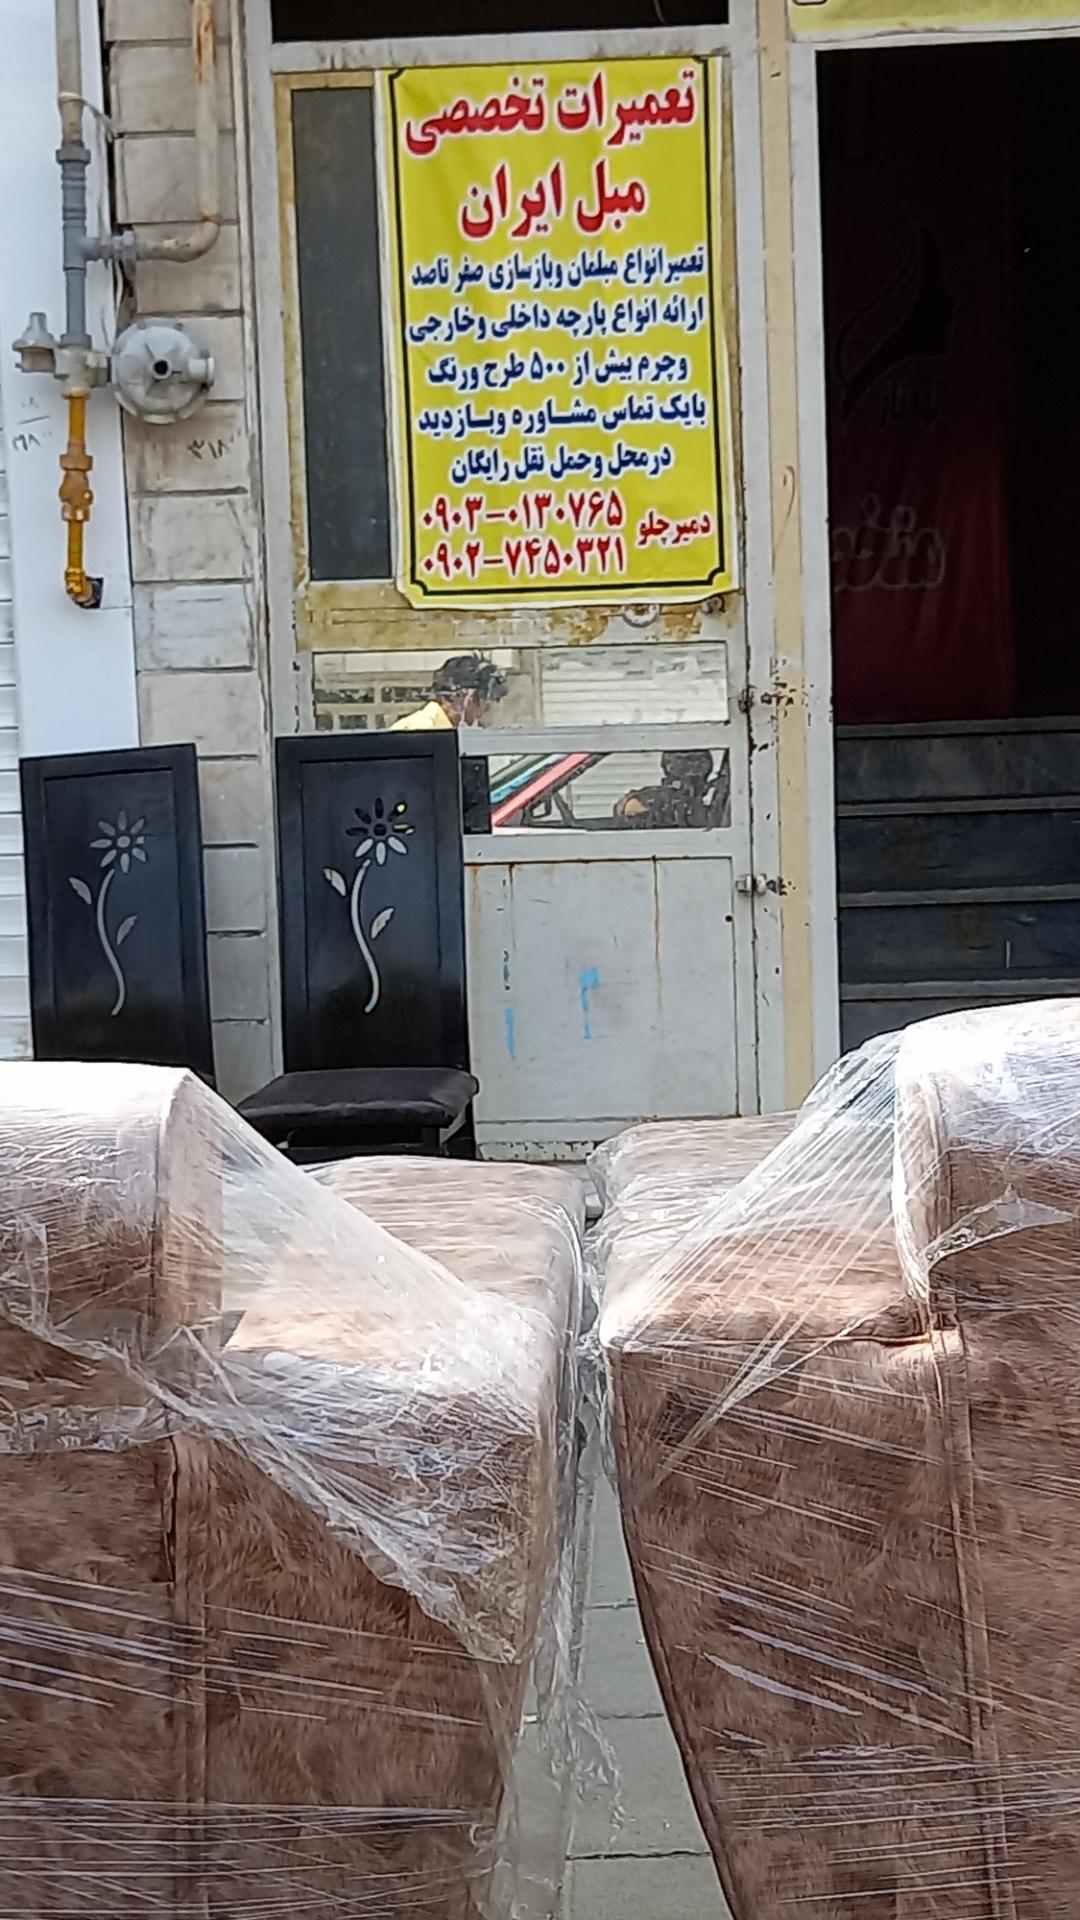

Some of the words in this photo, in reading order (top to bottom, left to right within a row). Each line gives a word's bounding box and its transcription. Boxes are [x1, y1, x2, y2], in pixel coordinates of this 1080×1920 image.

[406, 77, 545, 154] تخصصی
[557, 70, 695, 145] تعمیرات
[461, 162, 561, 238] ایران
[576, 159, 645, 232] مبل
[454, 256, 483, 293] صفر
[568, 249, 618, 287] مبلمان
[491, 303, 550, 338] داخلی
[557, 300, 606, 337] پارچه
[612, 298, 657, 333] انواع
[663, 294, 703, 331] ارائه
[484, 352, 525, 388] طرح
[530, 351, 565, 380] ۵۰۰
[573, 350, 589, 386] از
[595, 349, 632, 383] بیش
[602, 395, 653, 430] تماس
[451, 447, 509, 484] رایگان
[515, 446, 544, 480] نقل
